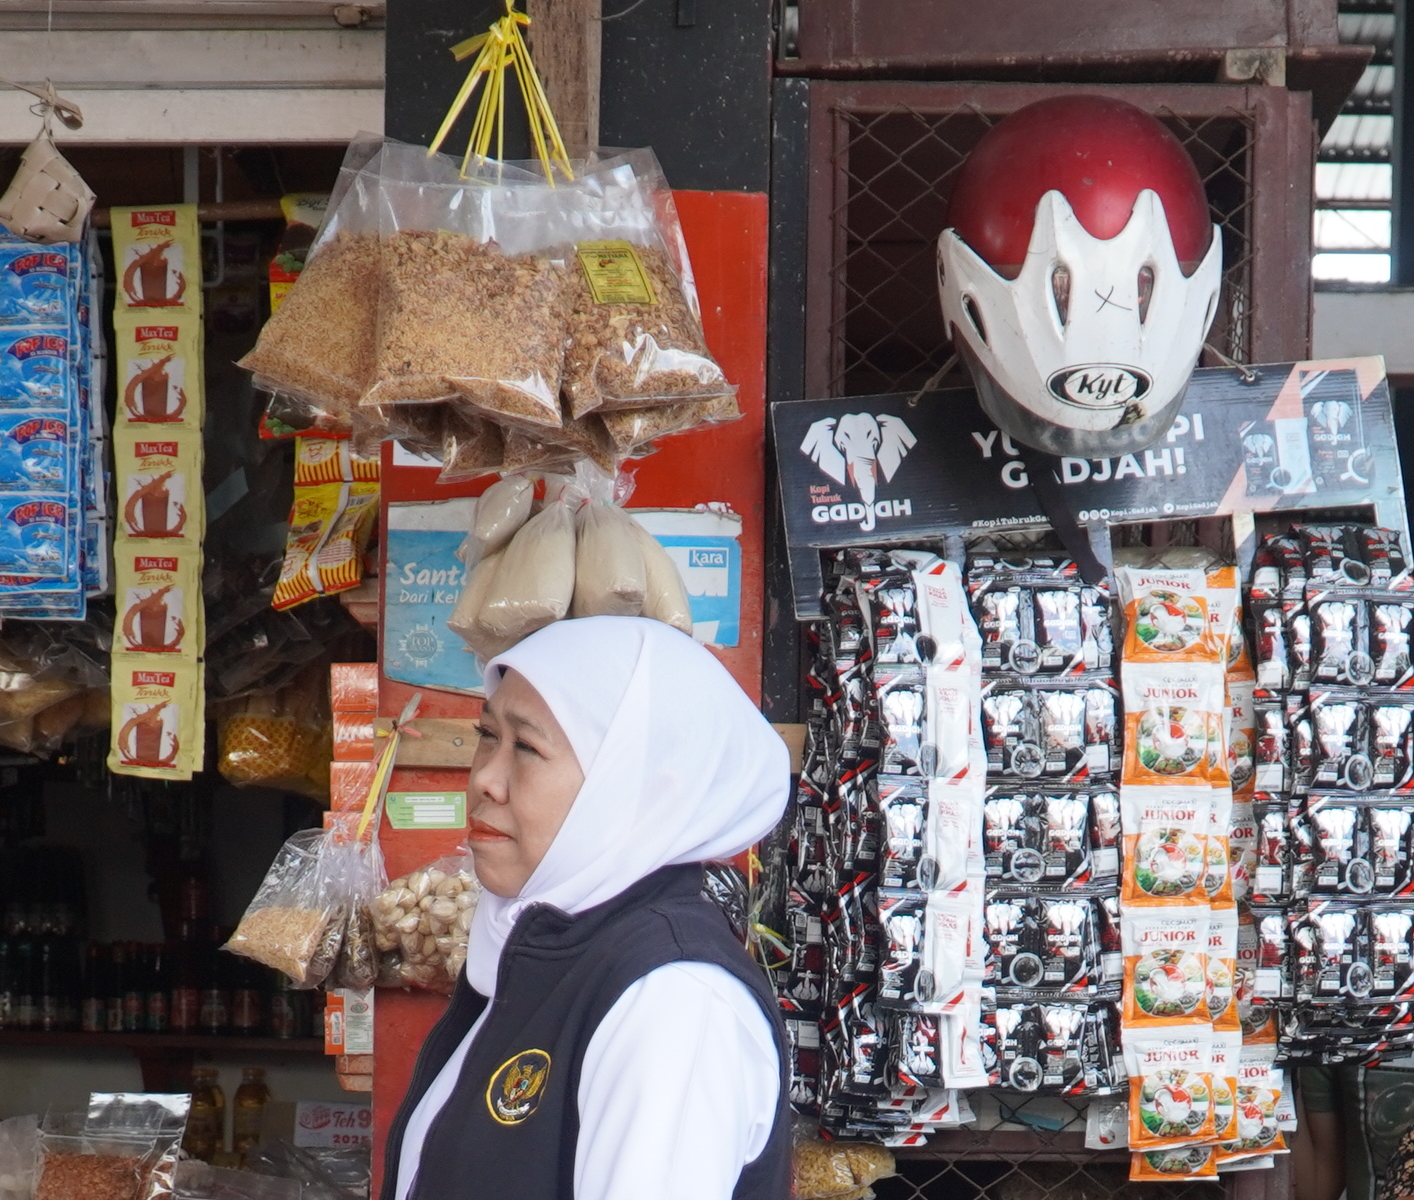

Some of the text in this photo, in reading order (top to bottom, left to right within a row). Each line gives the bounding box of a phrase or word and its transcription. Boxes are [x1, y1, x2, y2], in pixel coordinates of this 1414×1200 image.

[1076, 373, 1128, 400] Kyt
[1000, 446, 1187, 489] GDJAH!
[809, 484, 831, 497] Kopi
[809, 493, 843, 505] Tubruk
[971, 515, 1050, 529] #KopiTubrukGa
[691, 549, 726, 566] kara
[1137, 577, 1192, 590] JUNIOR
[398, 588, 459, 604] Dari Kel
[1142, 686, 1199, 699] JUNIOR
[1140, 808, 1197, 822] JUNIOR
[1139, 930, 1197, 943] JUNIOR
[1142, 1049, 1200, 1064] JUNIOR
